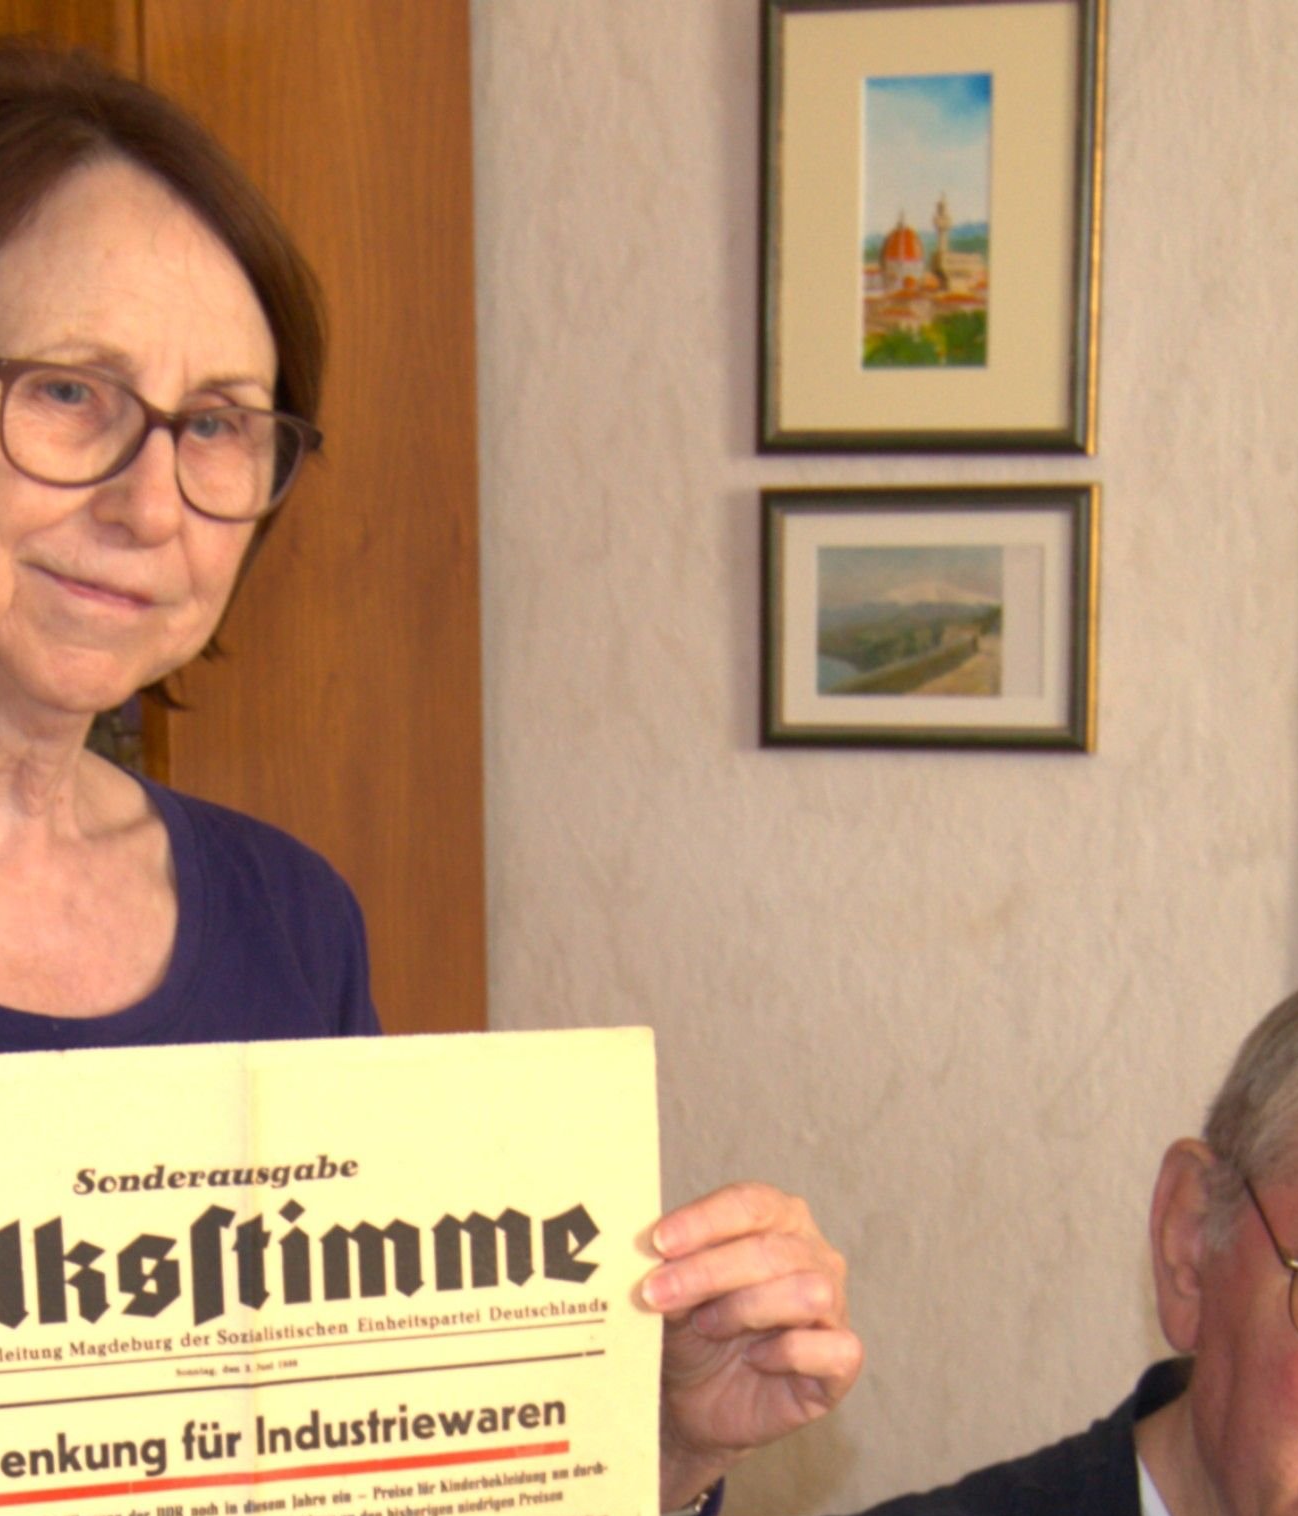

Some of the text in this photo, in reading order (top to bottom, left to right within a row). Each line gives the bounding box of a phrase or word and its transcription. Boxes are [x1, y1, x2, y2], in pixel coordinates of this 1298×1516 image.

[73, 1154, 358, 1195] Sonderausgabe
[69, 1336, 172, 1357] Magdeburg
[179, 1332, 209, 1347] der
[216, 1321, 348, 1344] Sozialistischen
[357, 1310, 480, 1332] Einheitspartei
[489, 1297, 608, 1320] Deutschlands
[181, 1420, 241, 1461] für
[255, 1400, 565, 1455] Industriewaren
